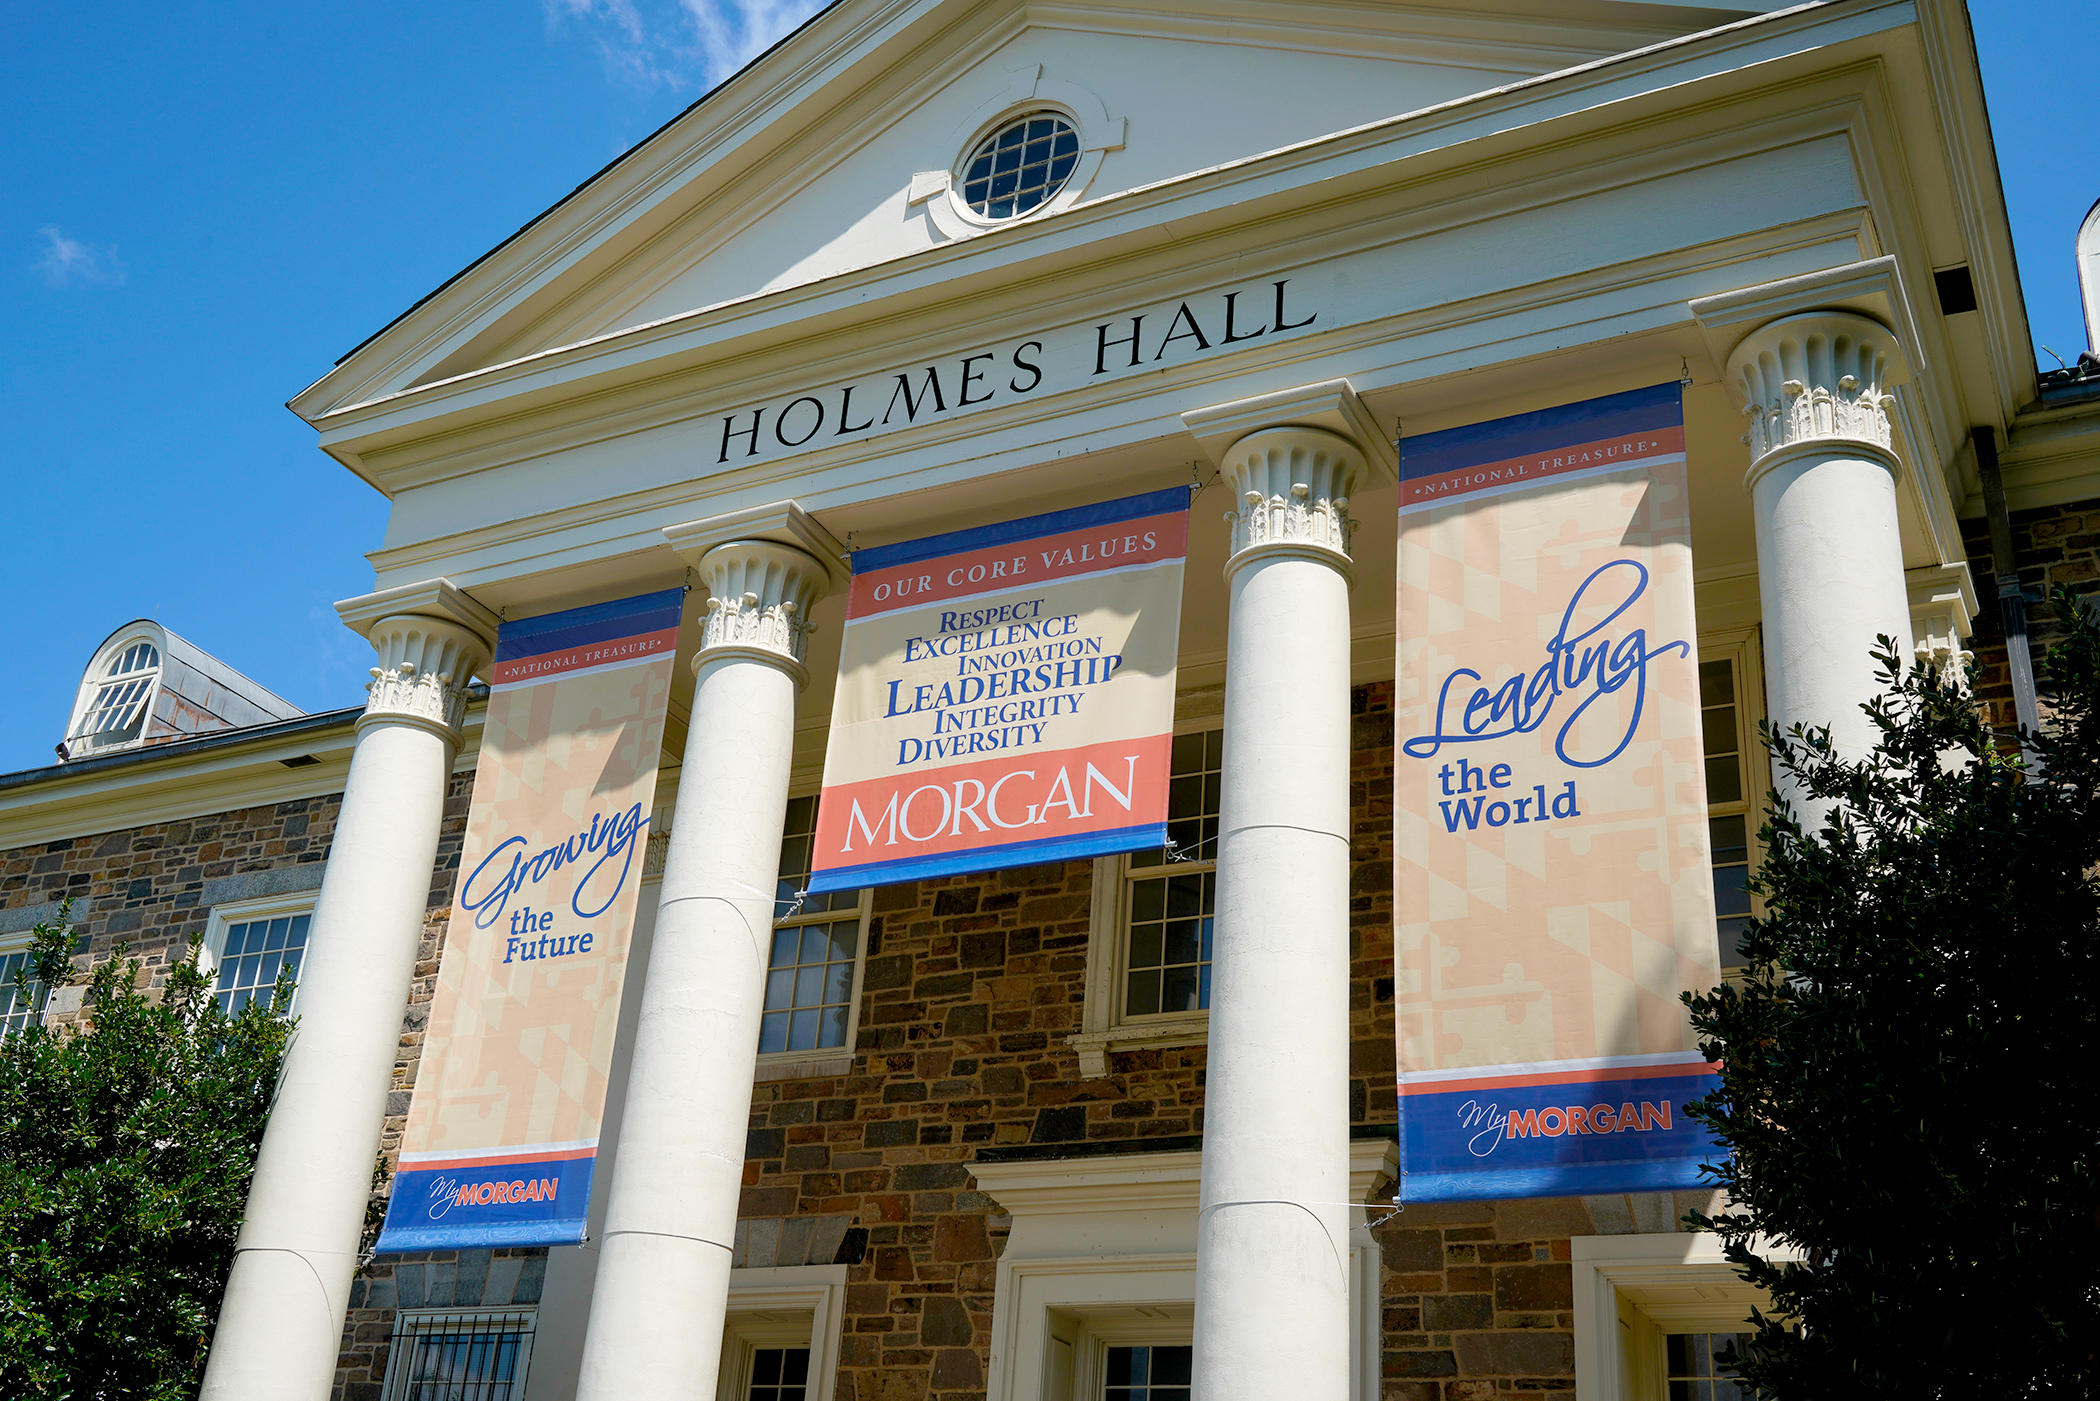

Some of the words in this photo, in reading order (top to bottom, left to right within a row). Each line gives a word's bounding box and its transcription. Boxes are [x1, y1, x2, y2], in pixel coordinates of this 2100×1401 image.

[716, 340, 1044, 465] HOLMES
[1091, 278, 1319, 376] HALL
[872, 573, 933, 602] OUR
[946, 555, 1028, 587] CORE
[1040, 531, 1159, 569] VALUES
[902, 613, 1079, 664] EXCELLENCE
[938, 598, 1045, 634] RESPECT
[957, 635, 1103, 677] INNOVATION
[1402, 558, 1690, 768] Leading
[882, 653, 1123, 719] LEADERSHIP
[932, 692, 1086, 736] INTEGRITY
[895, 720, 1049, 767] DIVERSITY
[1437, 757, 1513, 797] the
[839, 754, 1141, 854] MORGAN
[1438, 780, 1582, 834] World
[460, 801, 652, 930] Growing
[509, 905, 554, 936] the
[502, 930, 594, 965] Future
